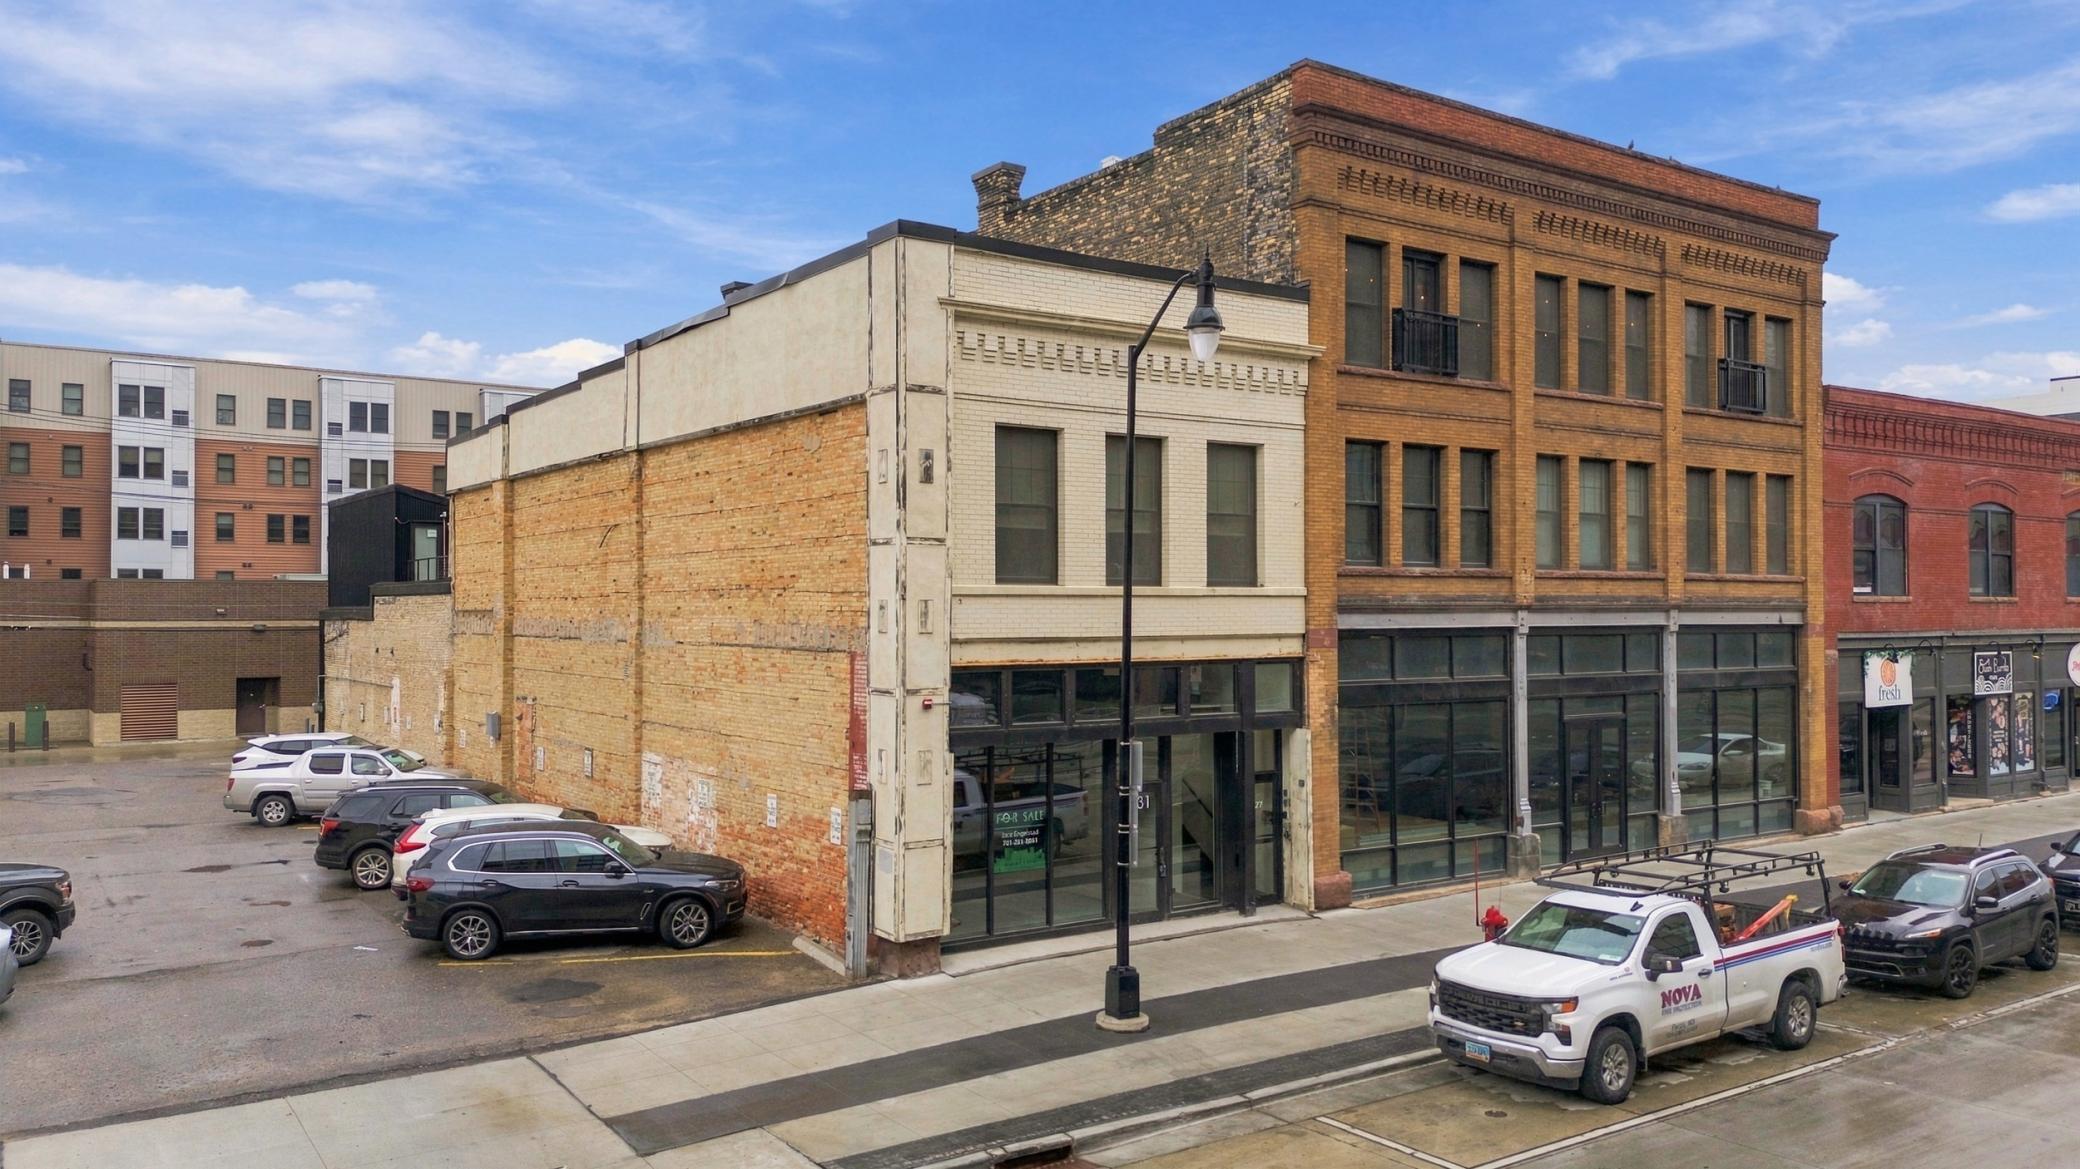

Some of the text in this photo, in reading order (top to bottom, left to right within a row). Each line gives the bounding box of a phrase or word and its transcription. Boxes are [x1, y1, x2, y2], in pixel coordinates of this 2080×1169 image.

[1878, 685, 1901, 701] fresh
[1136, 795, 1150, 809] 31
[996, 810, 1044, 824] FOR SALE
[1661, 983, 1702, 1008] NOVA
